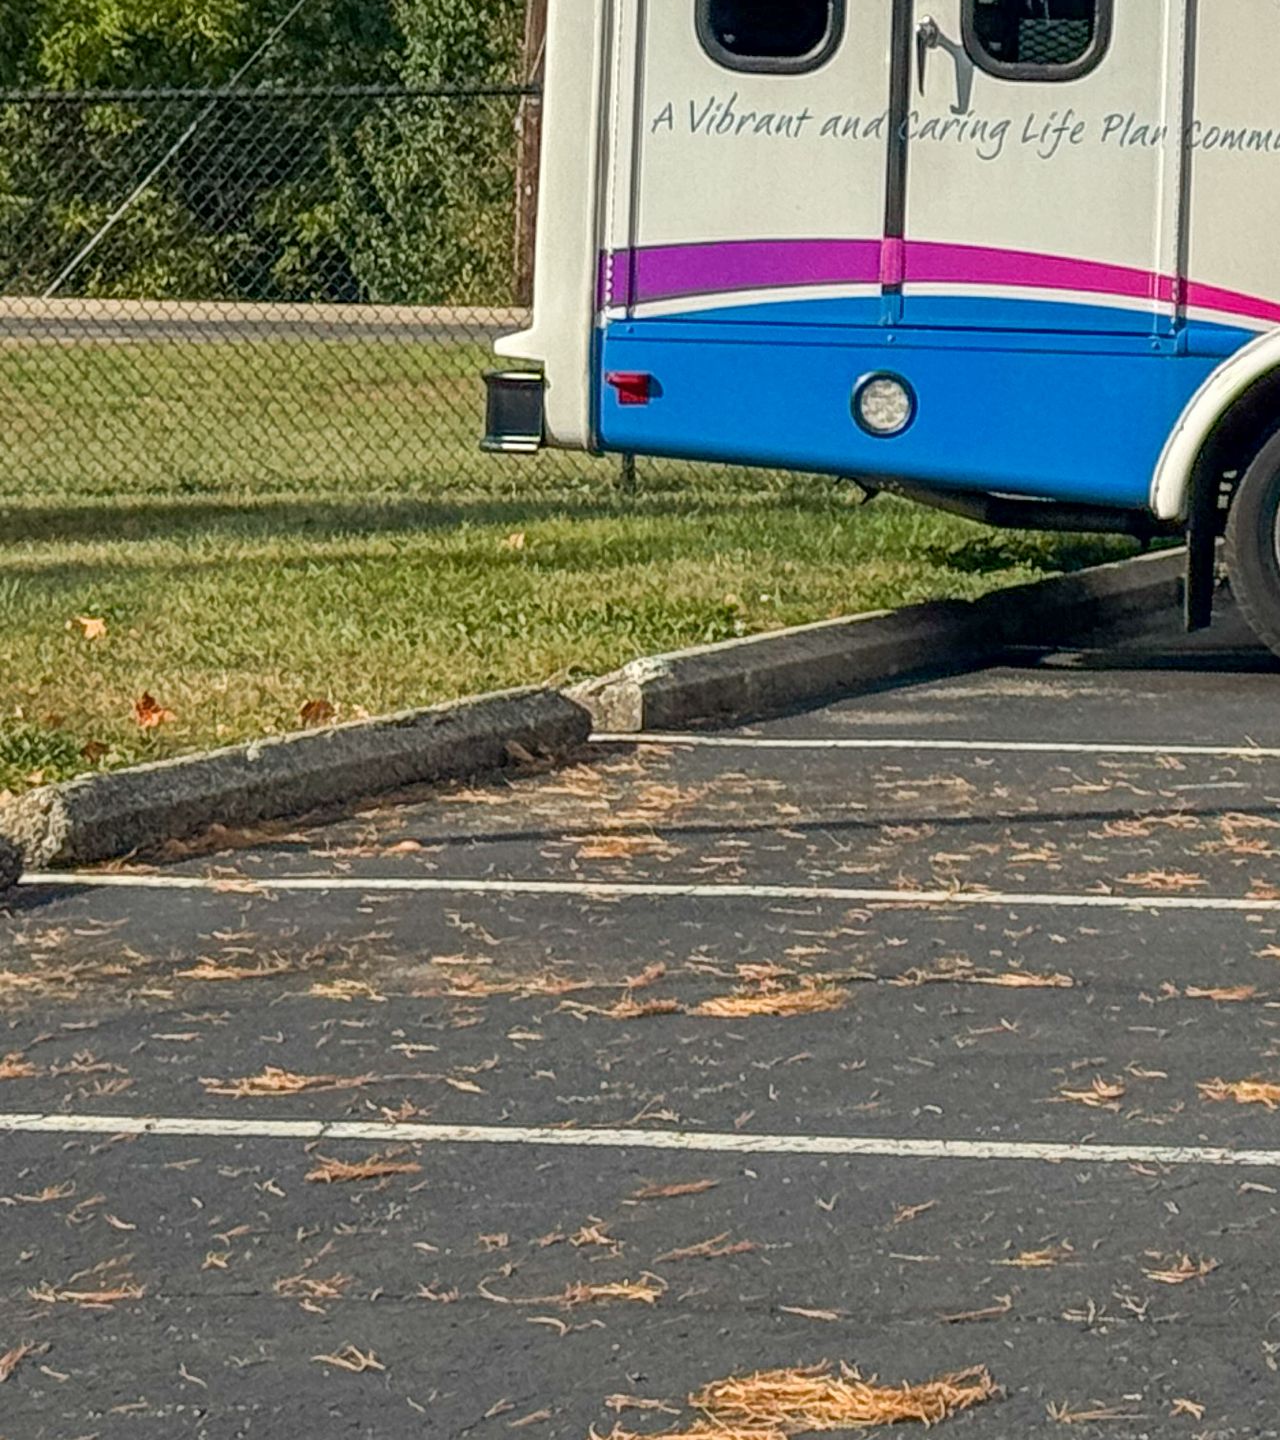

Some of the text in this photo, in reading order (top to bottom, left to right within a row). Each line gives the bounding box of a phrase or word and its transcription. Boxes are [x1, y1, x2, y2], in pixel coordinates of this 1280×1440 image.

[650, 101, 674, 134] A
[689, 90, 814, 138] Vibrant
[819, 109, 890, 139] and
[900, 108, 1012, 160] Caring
[1021, 108, 1086, 159] Life
[1101, 112, 1169, 149] Plan
